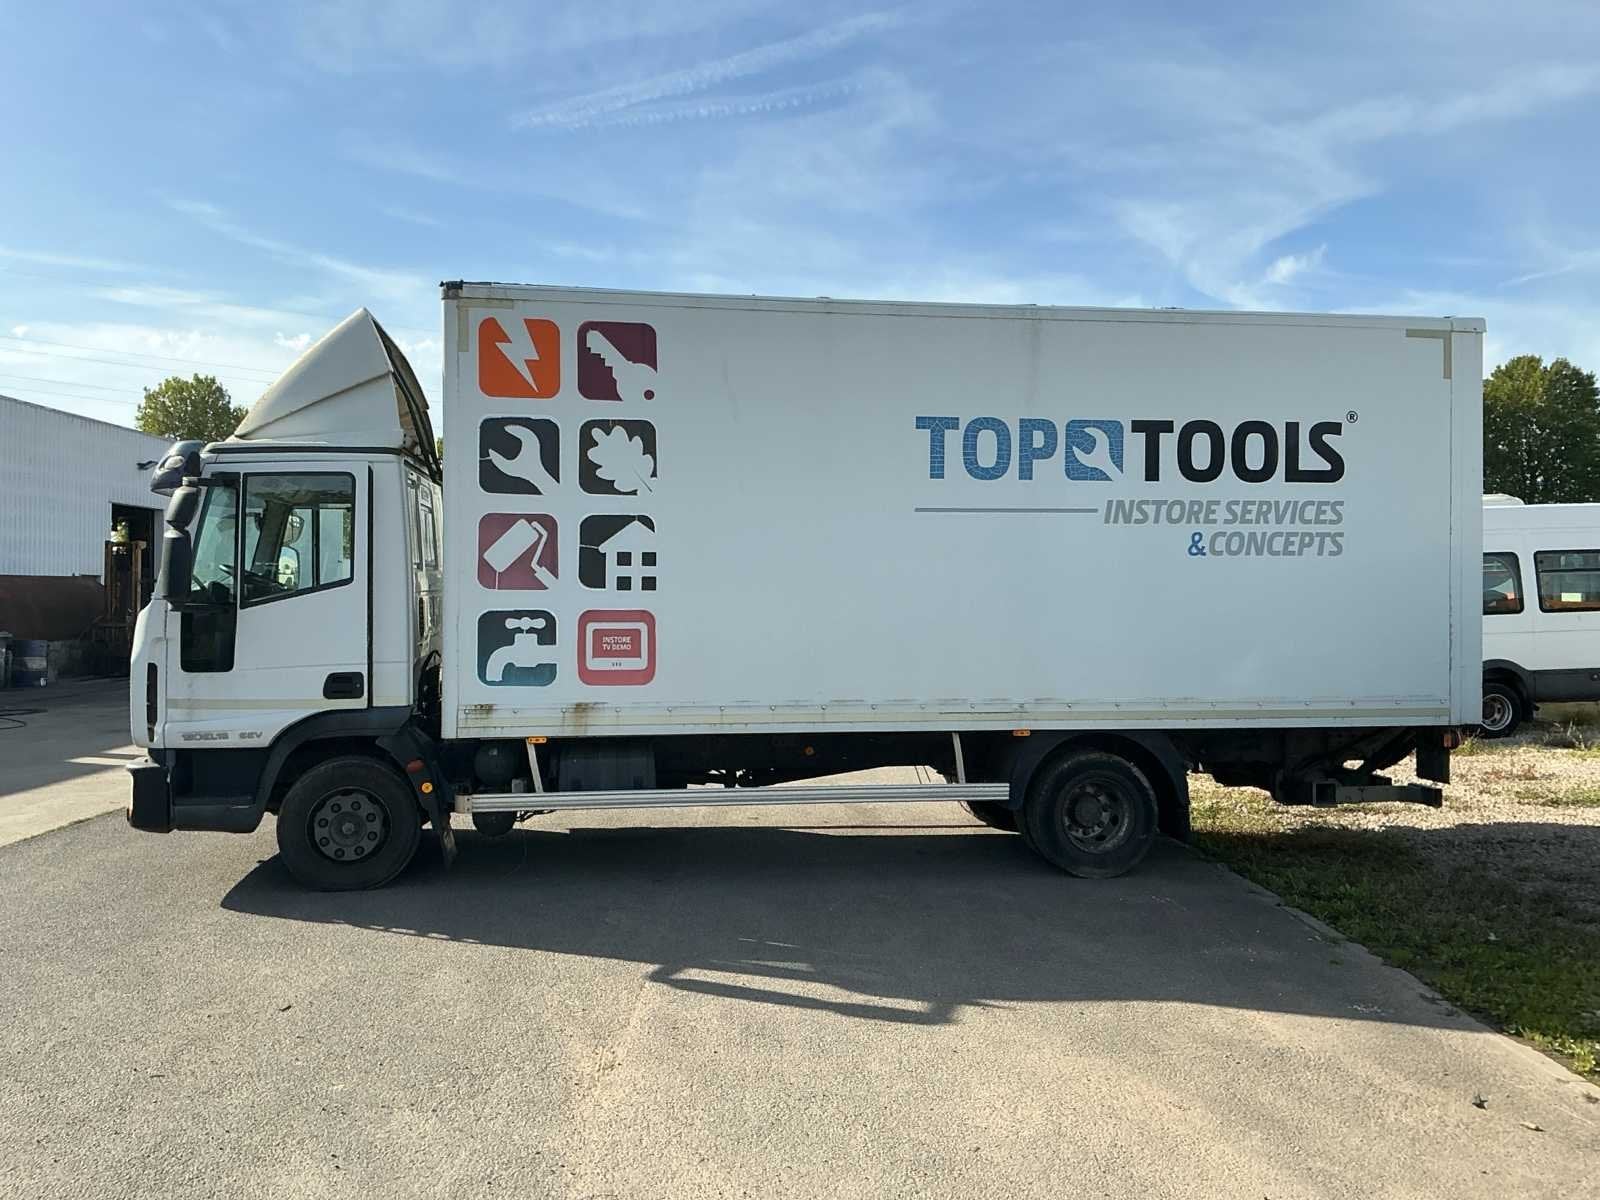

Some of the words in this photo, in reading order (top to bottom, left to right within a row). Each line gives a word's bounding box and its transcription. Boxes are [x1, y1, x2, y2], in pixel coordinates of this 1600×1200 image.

[915, 416, 1058, 481] TOP
[1103, 499, 1219, 525] INSTORE
[1222, 500, 1345, 525] SERVICES
